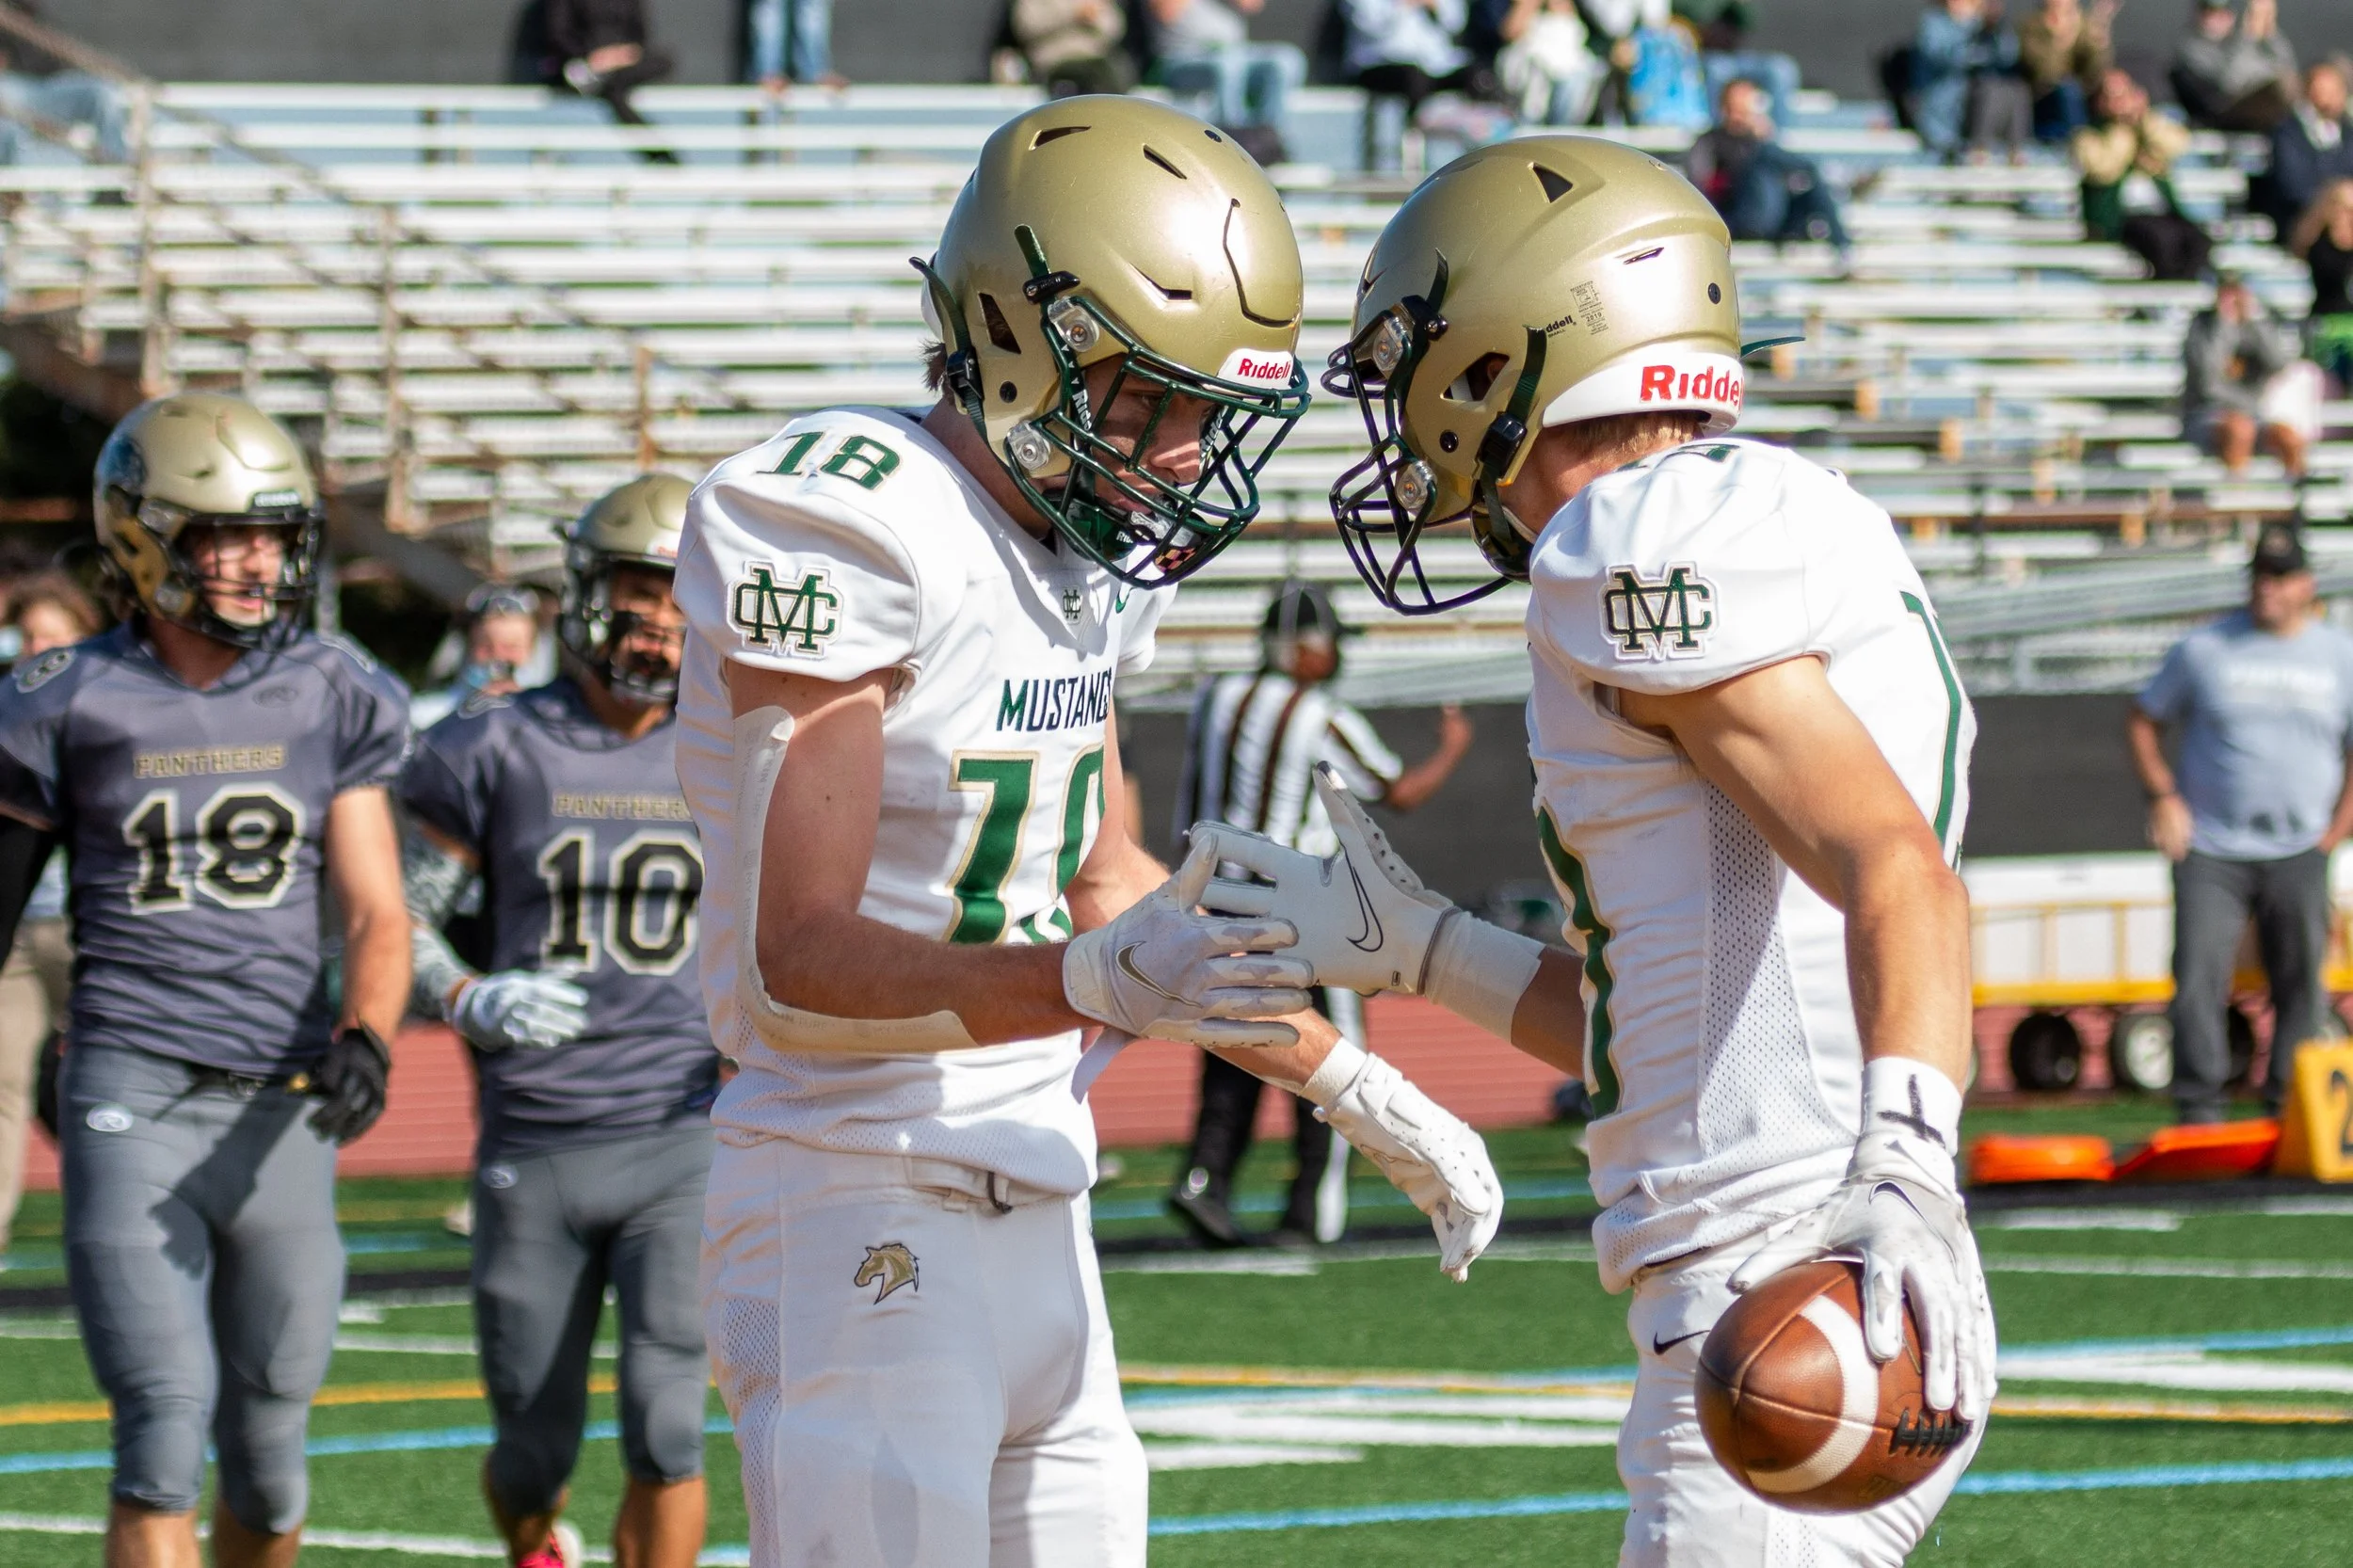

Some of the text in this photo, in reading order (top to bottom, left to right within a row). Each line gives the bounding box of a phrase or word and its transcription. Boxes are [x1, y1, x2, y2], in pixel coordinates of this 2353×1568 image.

[1545, 314, 1573, 333] ddell
[1585, 312, 1603, 322] 2019
[1238, 358, 1290, 379] Riddell
[1640, 364, 1745, 411] Ridde
[753, 428, 902, 492] 18
[996, 666, 1112, 732] MUSTANG
[135, 745, 286, 778] PANTHERS
[552, 793, 695, 822] PANTHER
[121, 781, 306, 916] 18
[536, 827, 705, 977] 10
